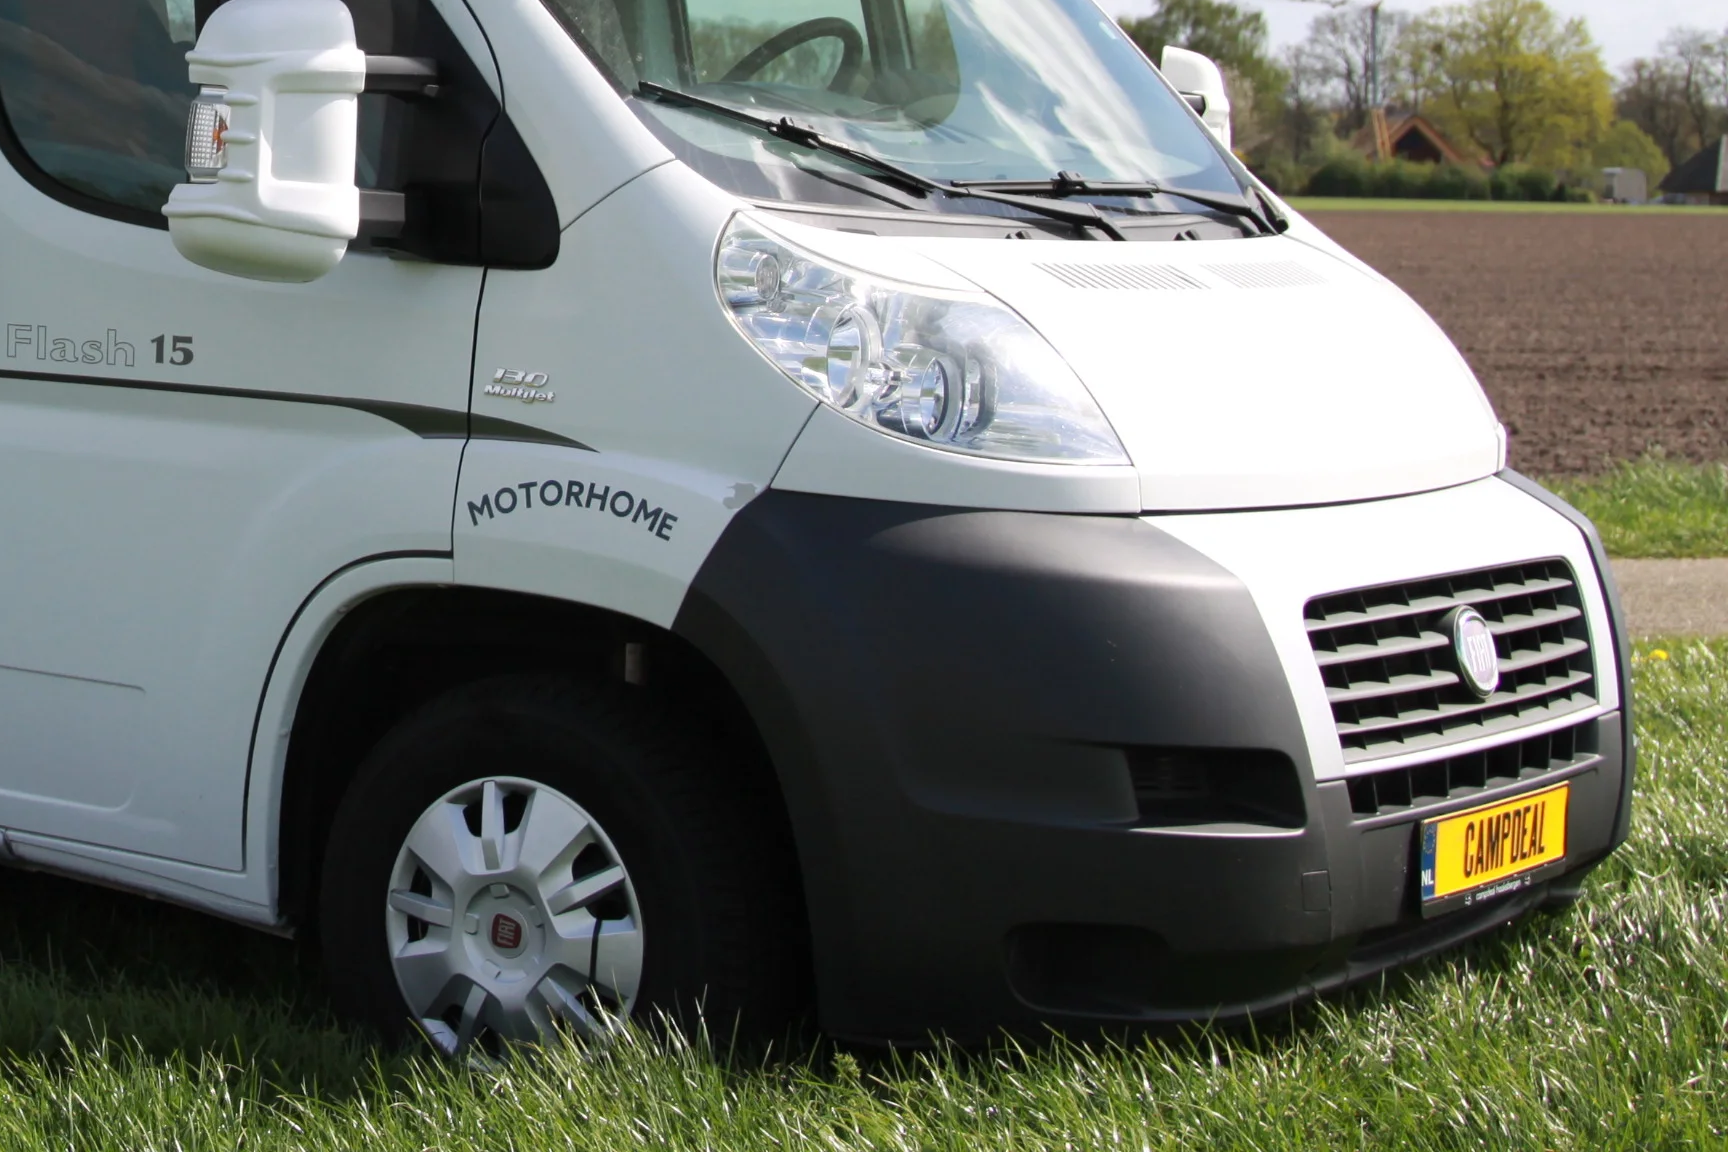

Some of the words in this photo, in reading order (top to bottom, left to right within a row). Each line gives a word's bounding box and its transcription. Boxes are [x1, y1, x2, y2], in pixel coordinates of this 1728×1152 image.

[7, 323, 135, 367] Flash
[150, 334, 194, 366] 15
[493, 367, 549, 388] 130
[467, 479, 678, 541] MOTORHOME
[1466, 633, 1492, 673] FIAT
[1463, 801, 1546, 879] CAMPDEAL
[1421, 868, 1434, 887] NL
[497, 918, 516, 946] FIAT
